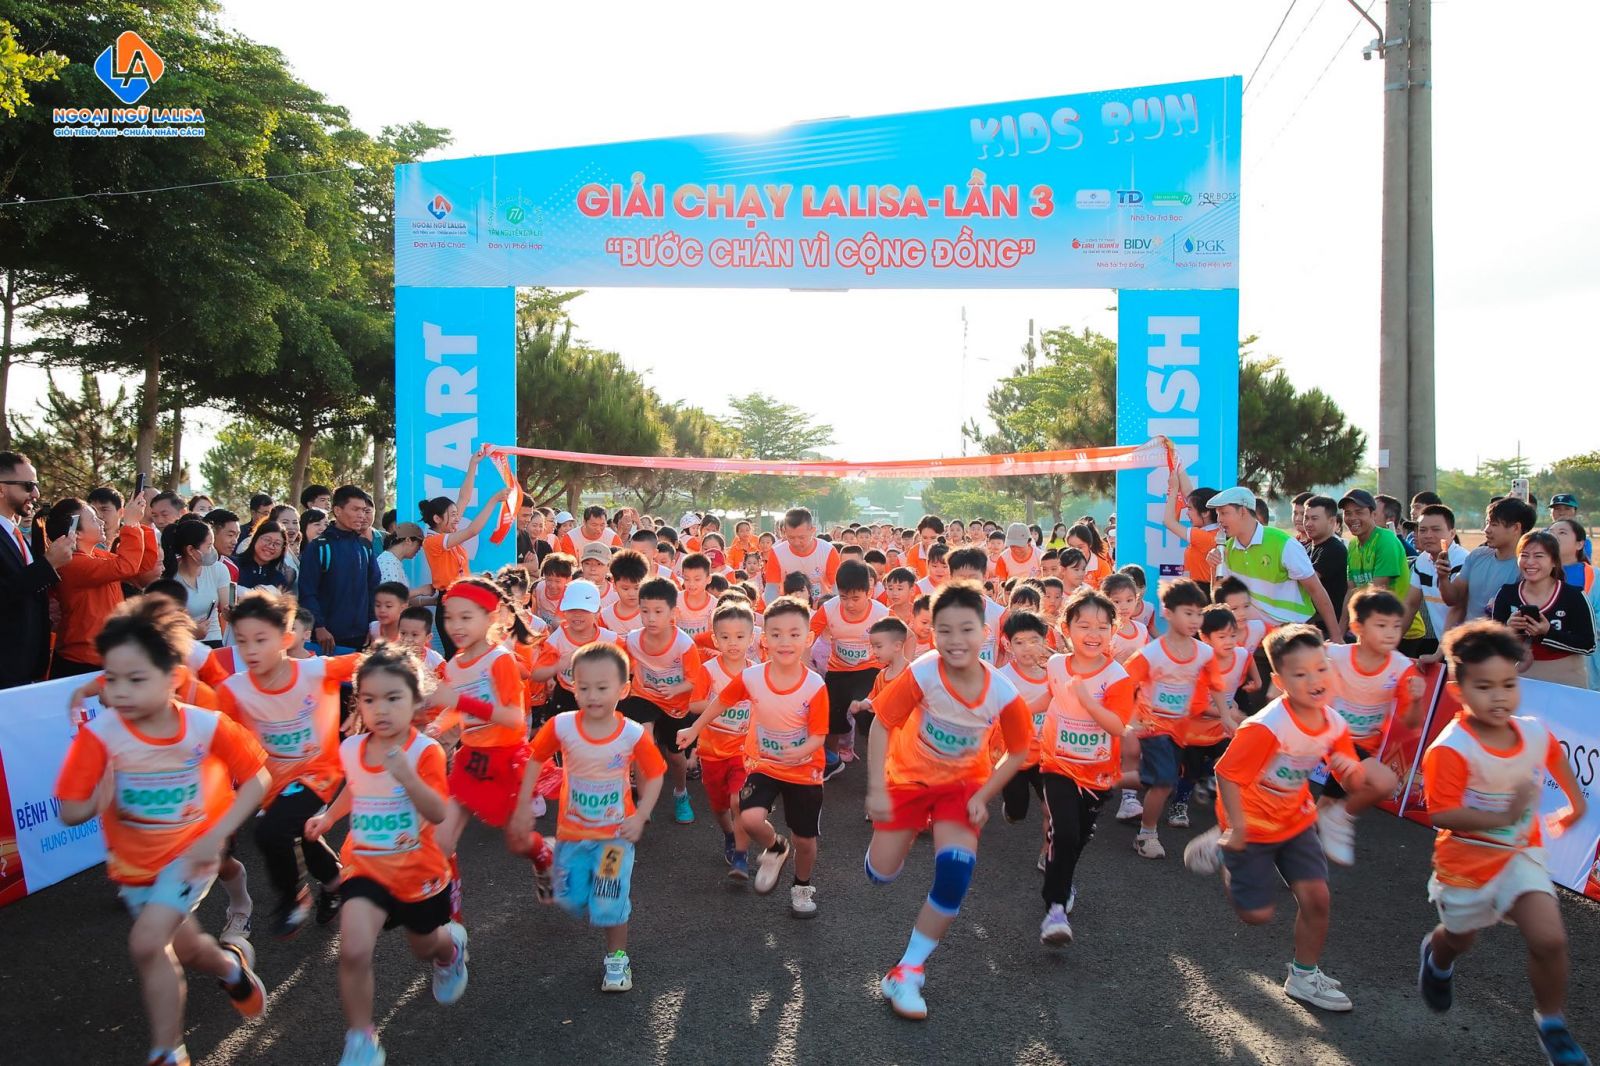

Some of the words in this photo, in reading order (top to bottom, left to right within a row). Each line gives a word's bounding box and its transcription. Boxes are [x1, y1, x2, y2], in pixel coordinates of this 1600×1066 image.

[970, 107, 1084, 160] KIDS
[1101, 93, 1199, 144] RUN
[576, 171, 665, 218] GIẢI
[672, 183, 793, 229] CHẠY
[801, 168, 1019, 219] LALISA-LẦN
[1030, 184, 1055, 219] 3
[709, 231, 794, 268] CHÂN
[799, 230, 830, 268] VÌ
[835, 231, 927, 276] CỘNG
[1124, 238, 1153, 250] BIDV
[1196, 239, 1225, 252] PGK
[1060, 729, 1107, 746] 80091
[16, 800, 48, 831] BỆNH
